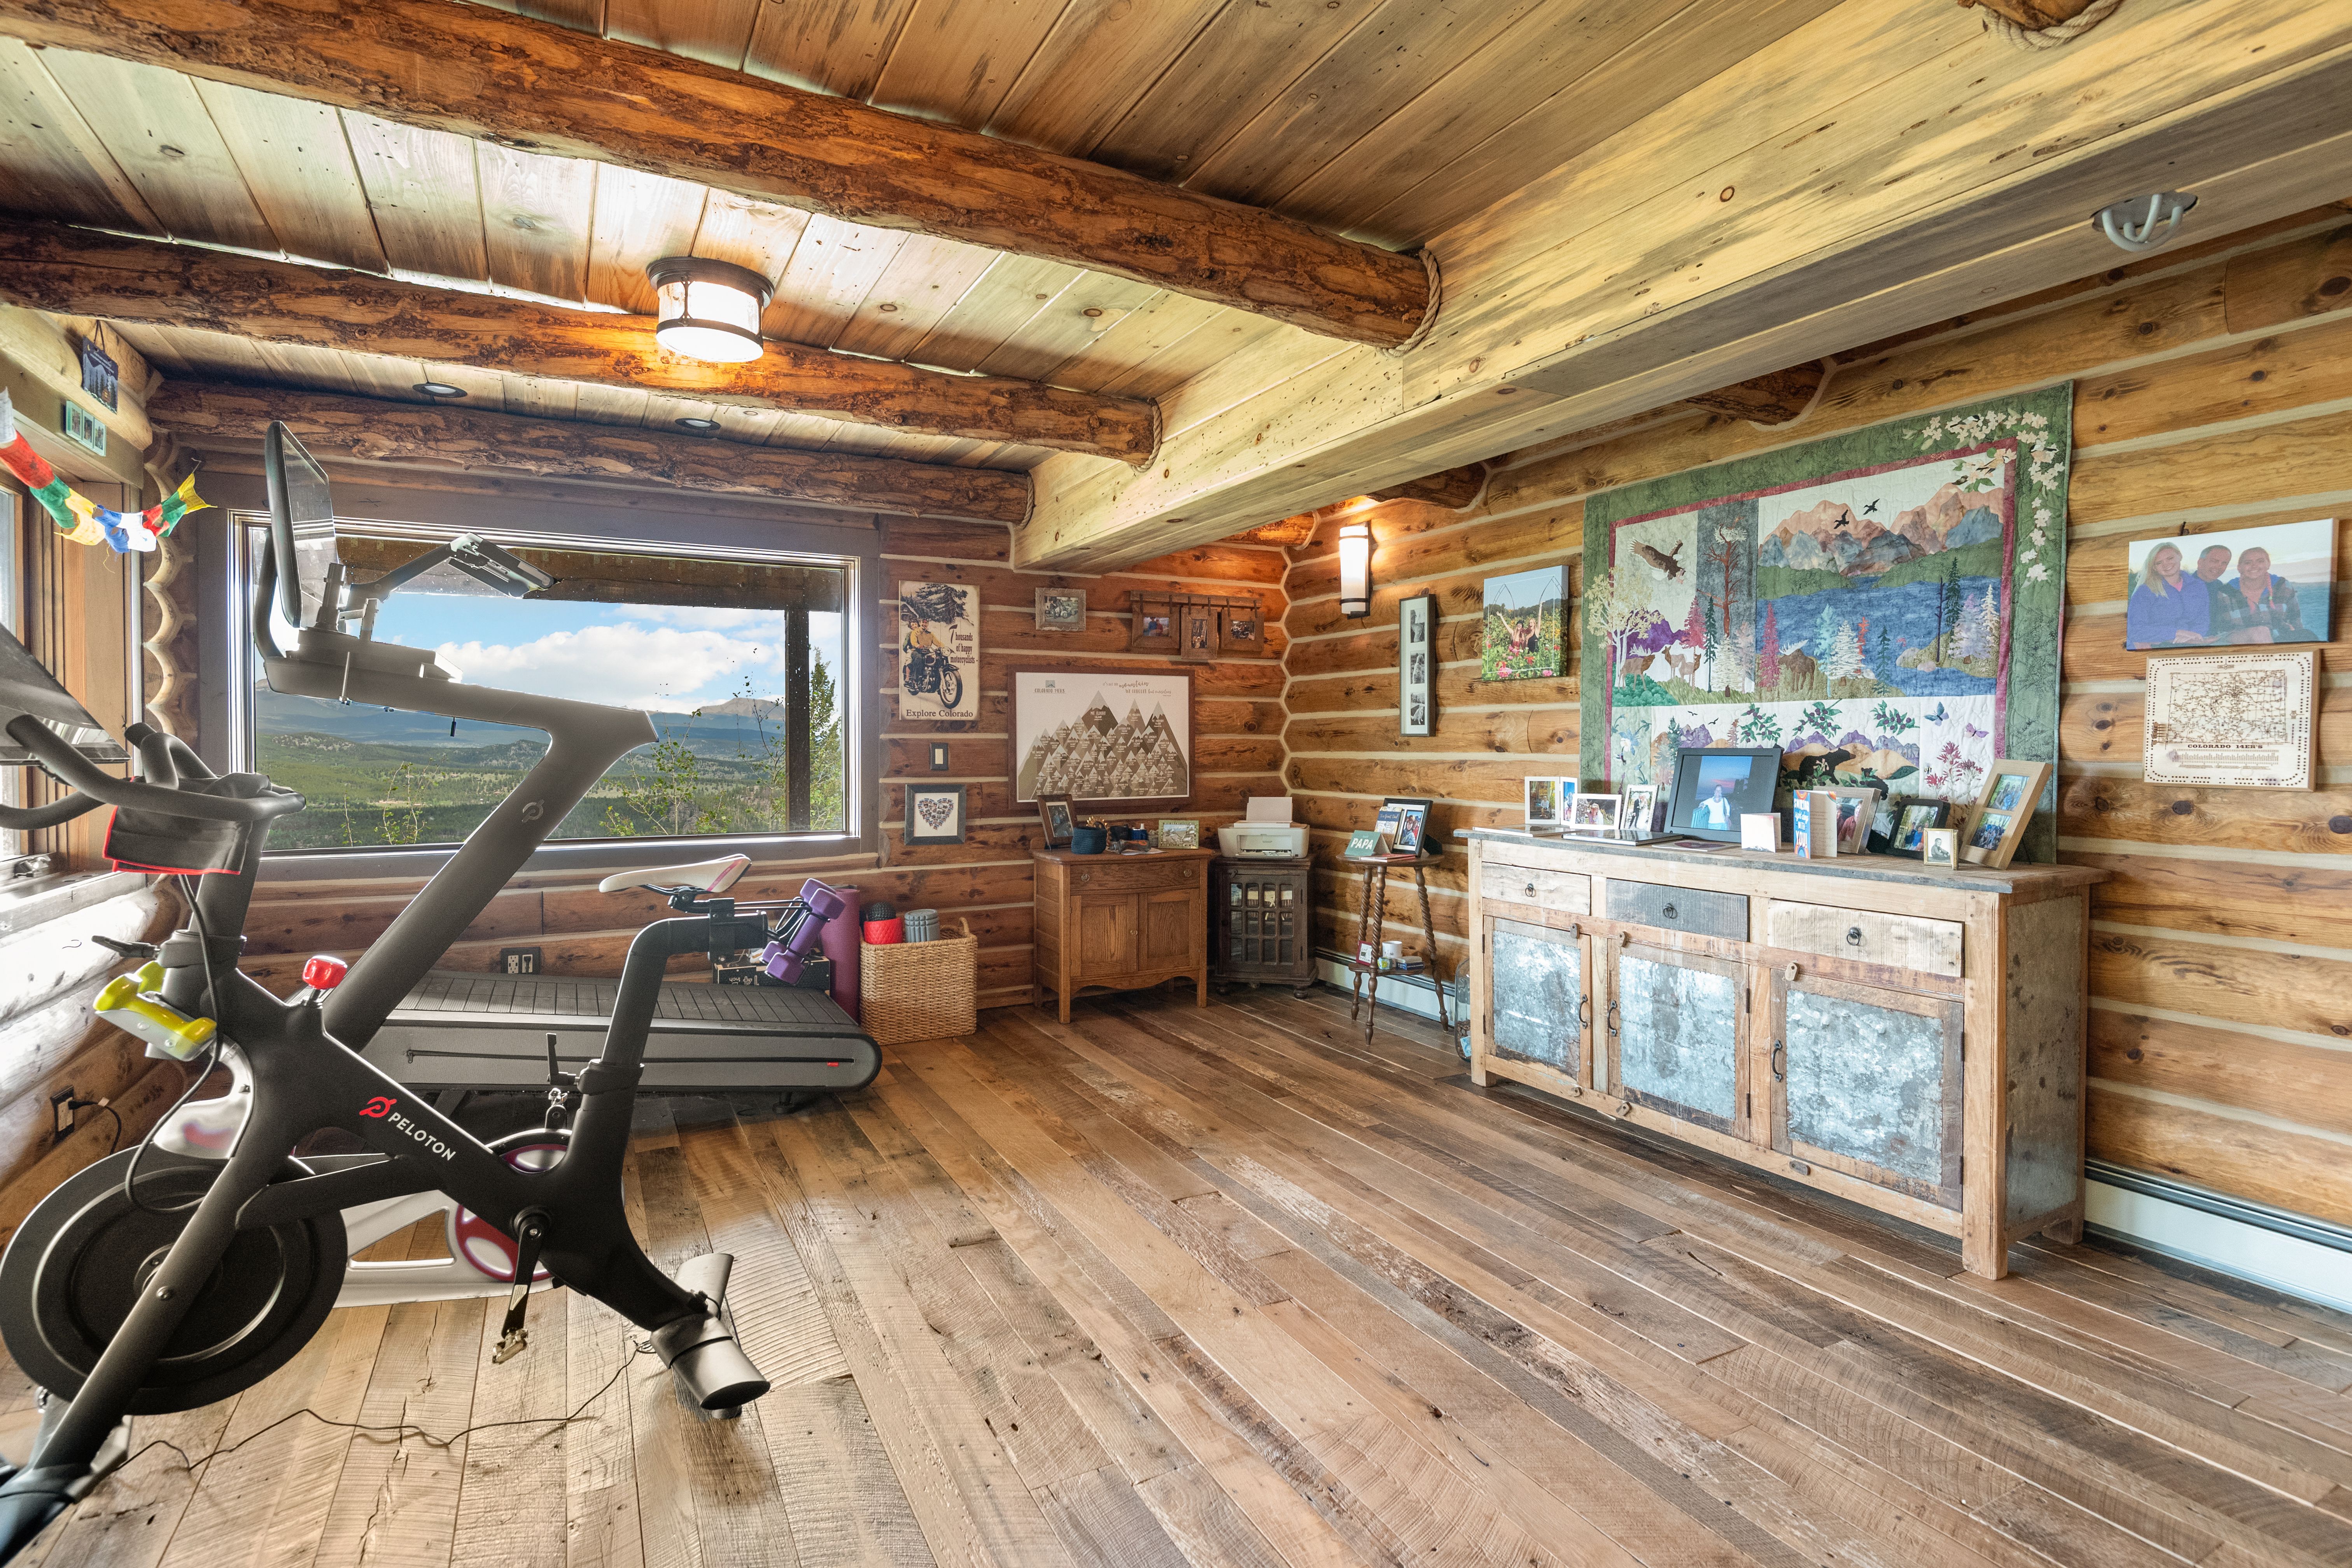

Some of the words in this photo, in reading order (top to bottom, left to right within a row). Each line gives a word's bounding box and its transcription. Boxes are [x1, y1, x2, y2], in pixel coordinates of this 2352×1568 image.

[949, 624, 973, 644] Thousands
[956, 644, 961, 652] of
[961, 644, 972, 654] happy
[950, 655, 975, 665] motorcyclists
[1119, 680, 1150, 688] mountain
[906, 709, 936, 718] Explore
[1350, 838, 1374, 850] PAPA
[1796, 830, 1808, 849] YOU!
[388, 1112, 456, 1161] PELOTON
